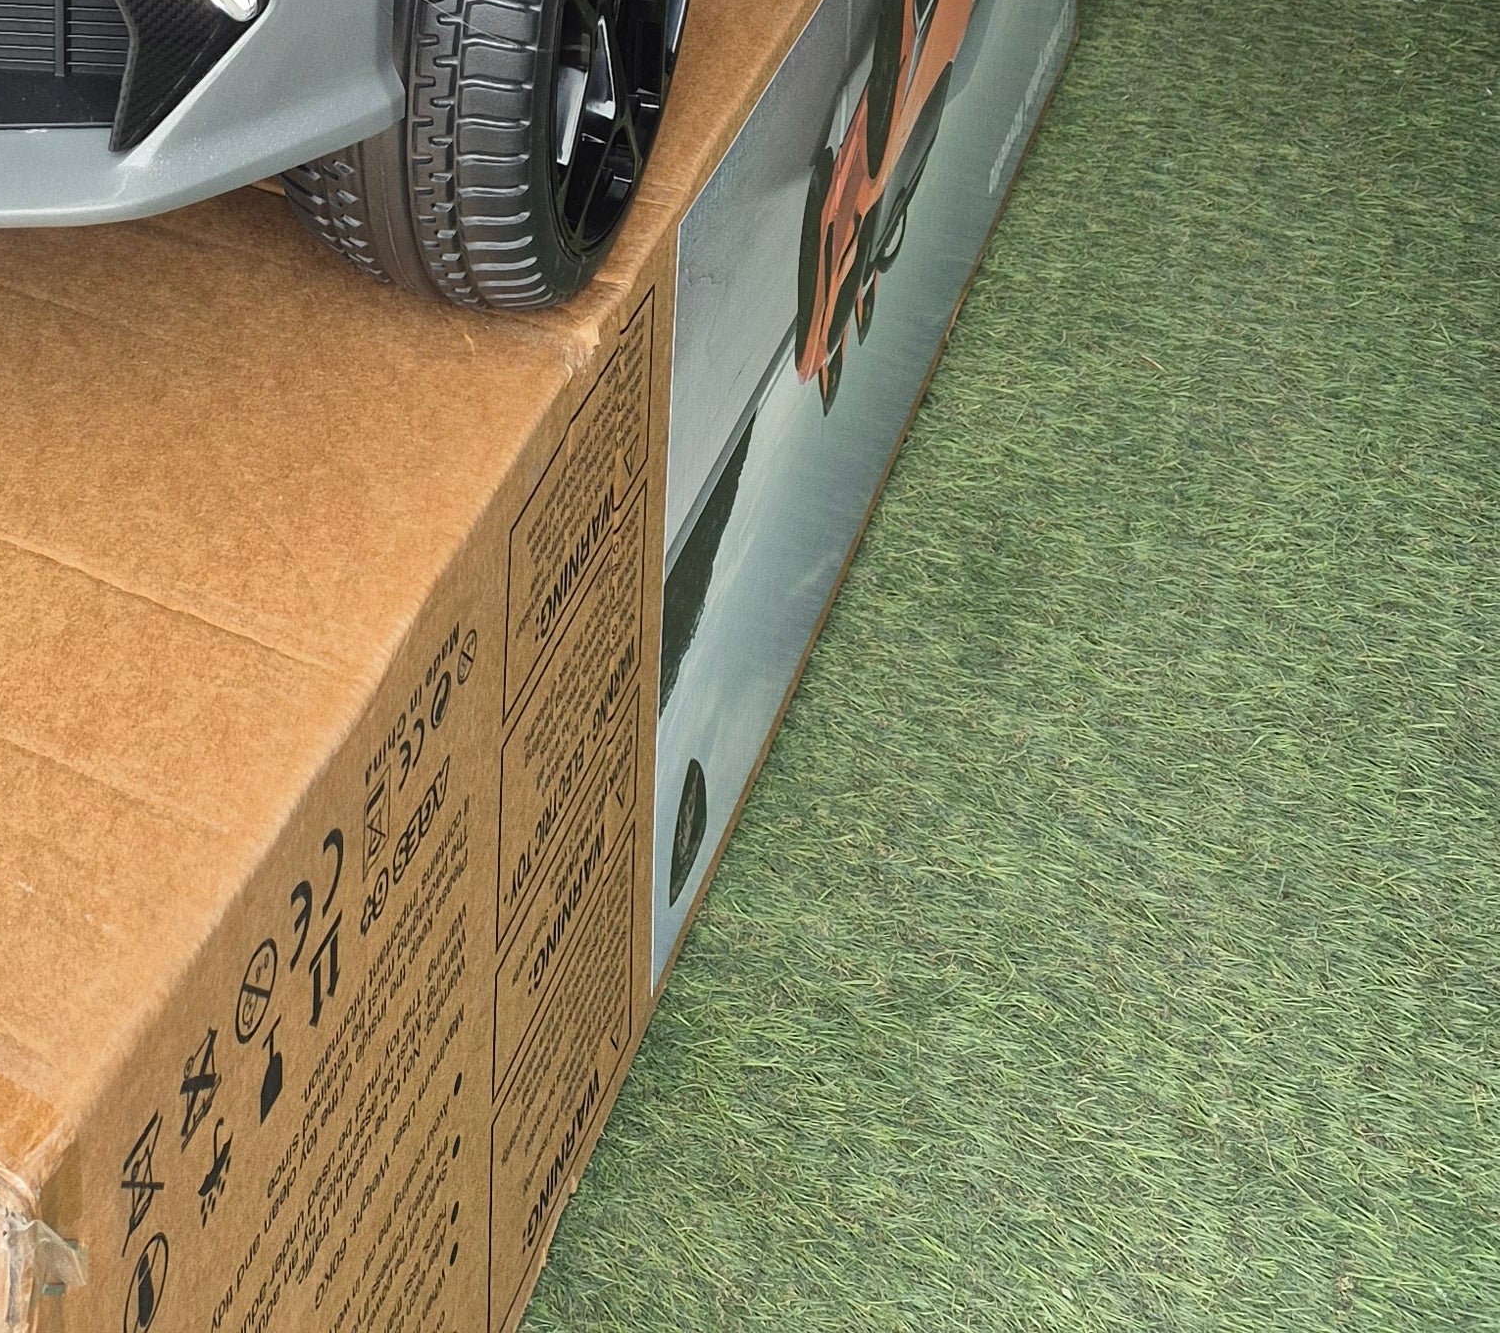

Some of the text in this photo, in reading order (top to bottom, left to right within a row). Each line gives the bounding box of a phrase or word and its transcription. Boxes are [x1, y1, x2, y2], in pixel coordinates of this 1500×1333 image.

[535, 482, 614, 642] WARNING:
[361, 755, 450, 936] AGES 6+
[364, 712, 407, 788] China
[510, 736, 584, 908] ELECTRIC TOY
[268, 825, 468, 1198] The packaging must be retained since
[305, 810, 461, 1103] contains important information.
[528, 801, 605, 995] WARNING:
[211, 848, 468, 1333] Please keep the inside of the toy clean and tidy
[270, 903, 466, 1286] Warning: The toy must be used under
[296, 955, 465, 1284] Warning: used in traffic.
[315, 1003, 464, 1310] Maximum User Weight: 60KG
[320, 928, 466, 1221] Warning: Must be assembled
[520, 1044, 599, 1288] WARNING:
